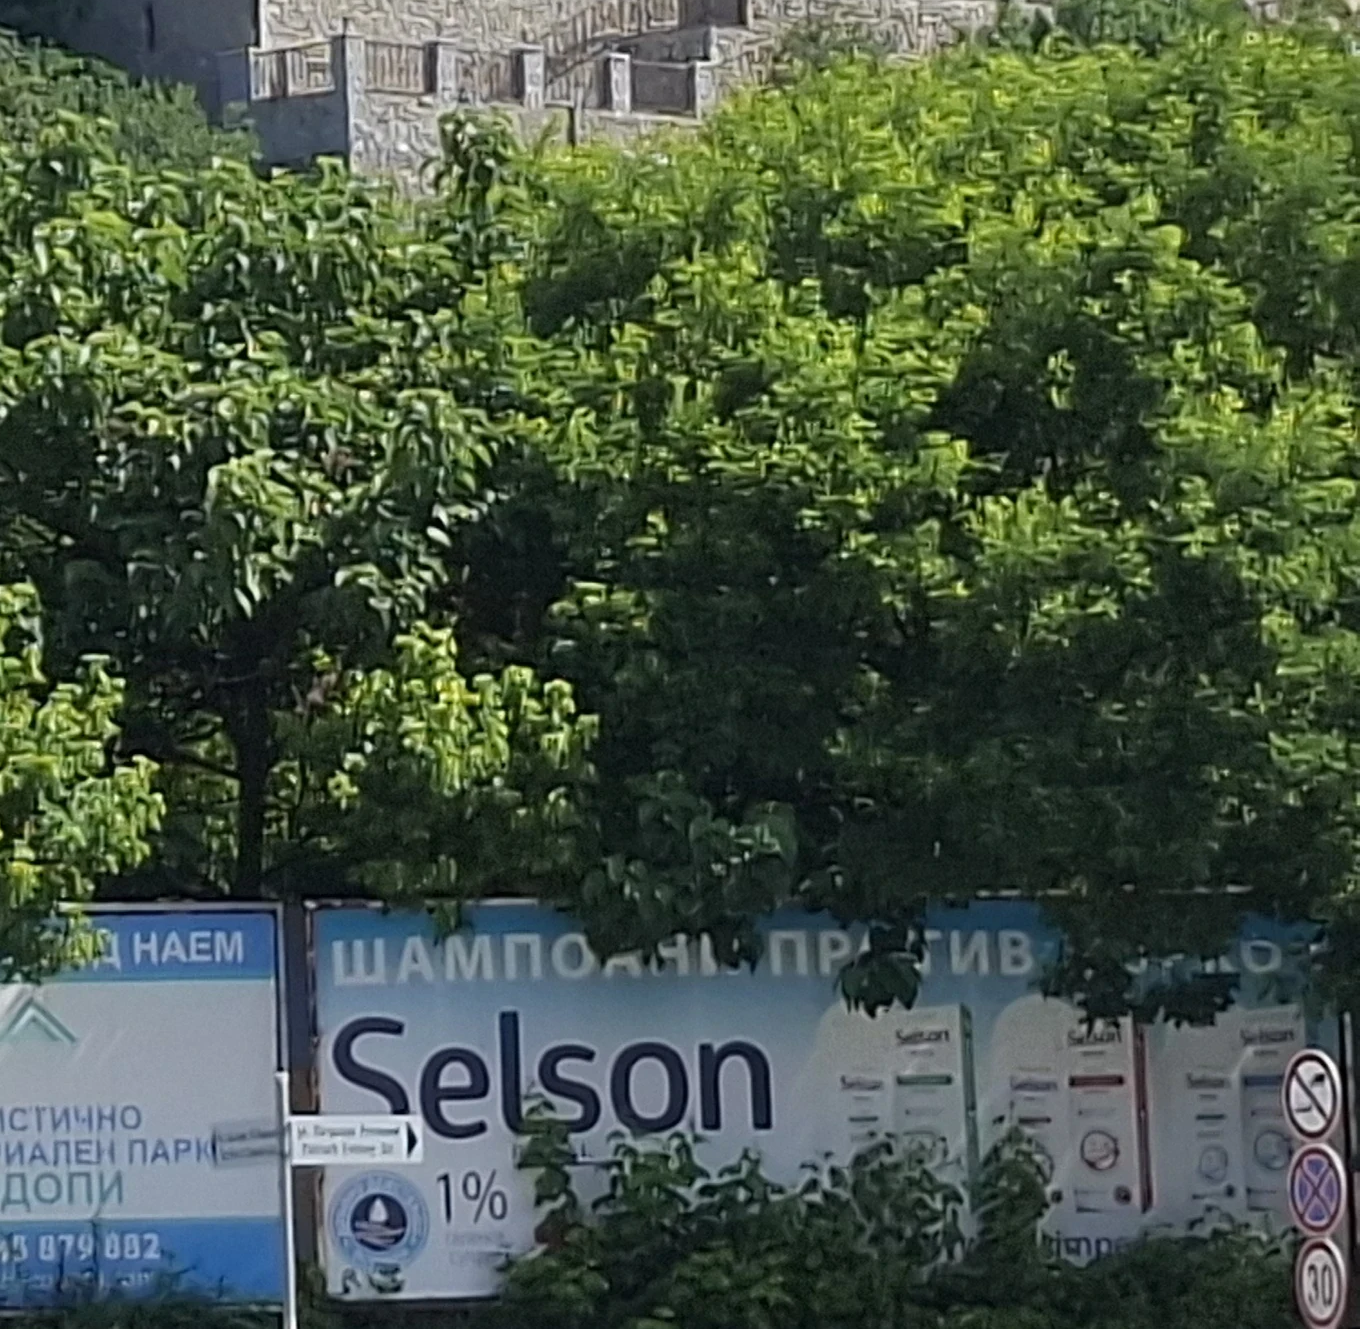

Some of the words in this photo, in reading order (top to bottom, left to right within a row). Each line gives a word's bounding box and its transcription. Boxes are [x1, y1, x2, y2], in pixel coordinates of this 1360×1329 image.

[133, 930, 244, 964] НАЕМ
[769, 928, 1036, 976] ПРТИВ
[331, 1010, 773, 1140] Selson
[129, 1136, 212, 1167] ПАРК
[436, 1169, 508, 1225] 1%
[1308, 1263, 1334, 1307] 30
